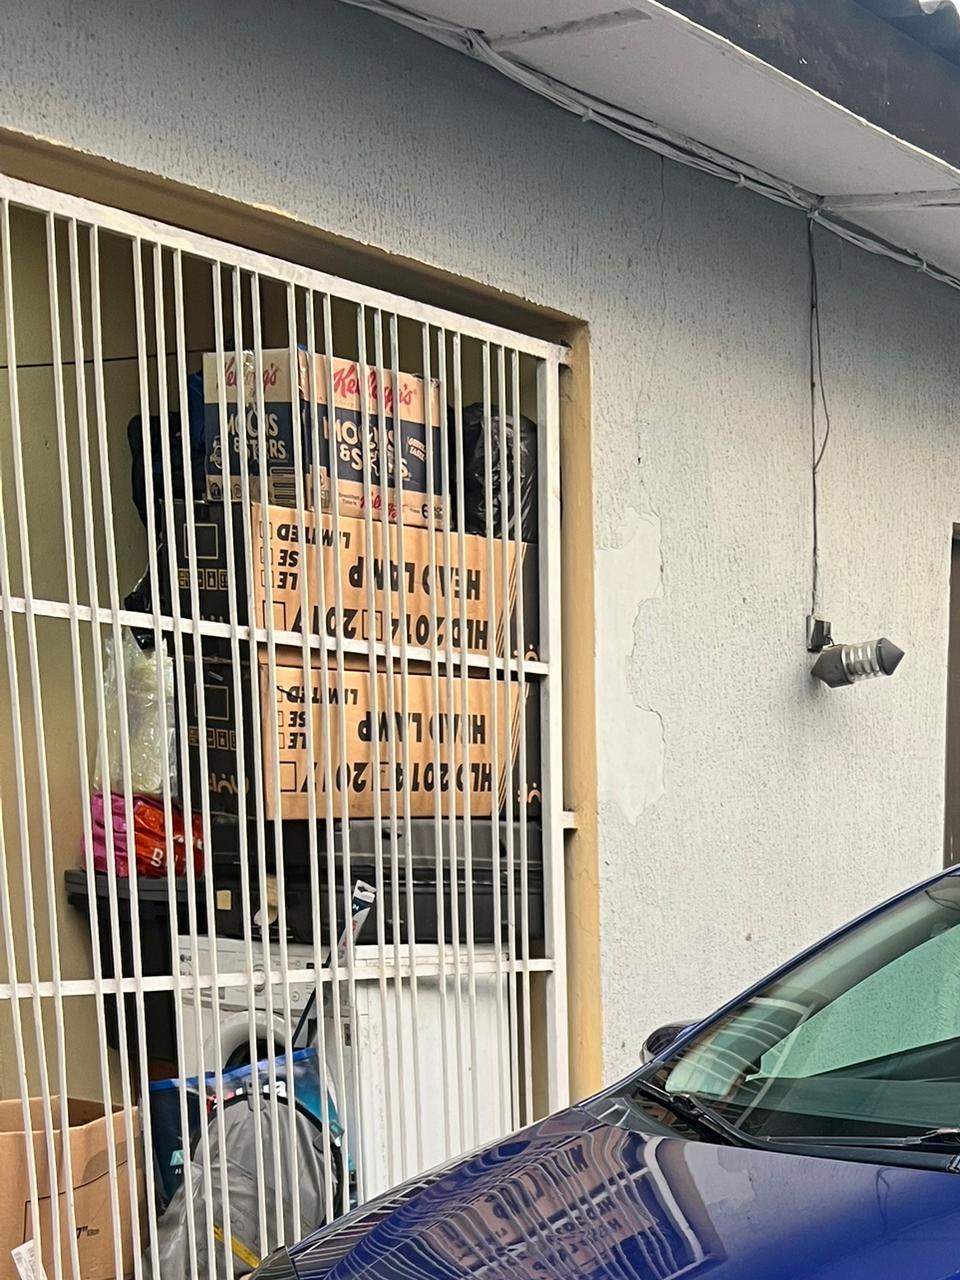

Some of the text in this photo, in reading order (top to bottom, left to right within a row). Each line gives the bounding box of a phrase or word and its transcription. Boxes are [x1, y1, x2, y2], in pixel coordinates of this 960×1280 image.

[277, 523, 351, 549] LMITED
[278, 549, 299, 568] SE
[277, 571, 298, 591] LE
[288, 710, 306, 728] SE
[288, 732, 306, 750] LE
